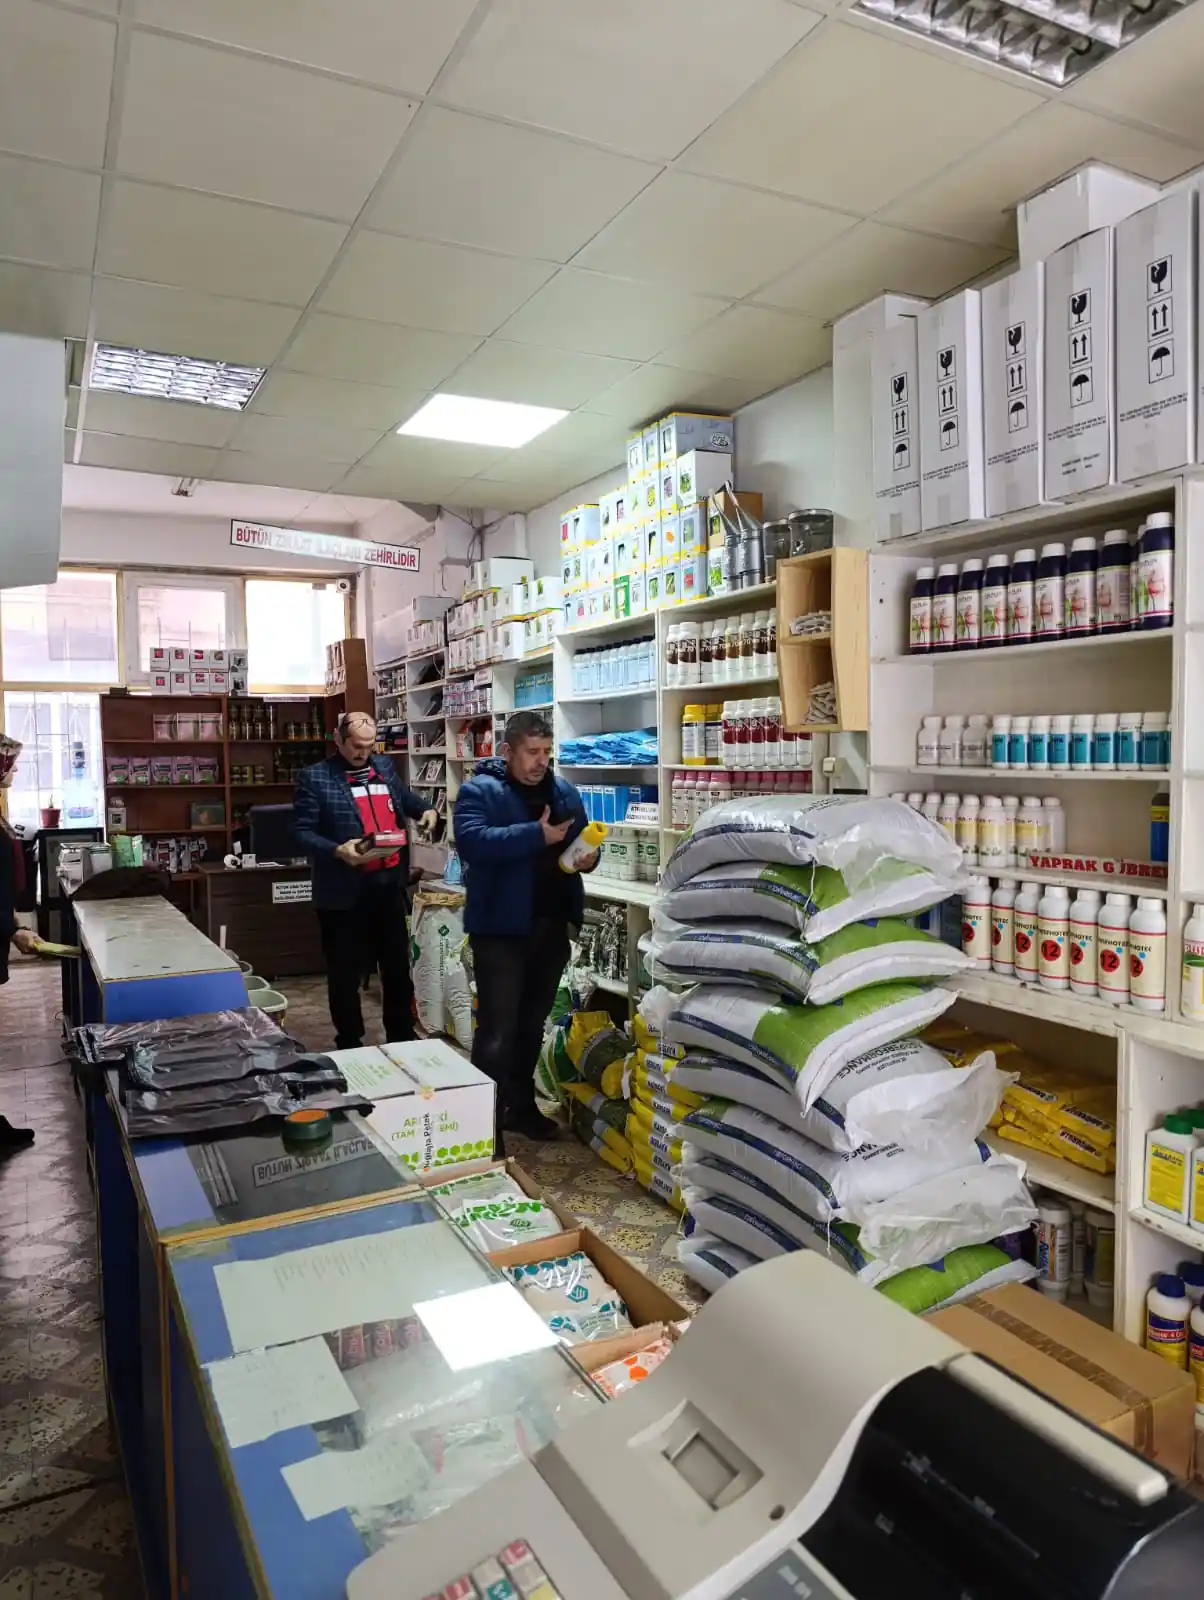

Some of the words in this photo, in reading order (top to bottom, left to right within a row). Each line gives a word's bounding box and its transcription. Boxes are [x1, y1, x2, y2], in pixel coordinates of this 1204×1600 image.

[236, 526, 273, 546] BÜTÜN
[364, 547, 416, 567] ZEHİRLİDİR
[1029, 855, 1098, 872] YAPRAK
[1041, 940, 1059, 957] 12
[1100, 950, 1117, 968] 12
